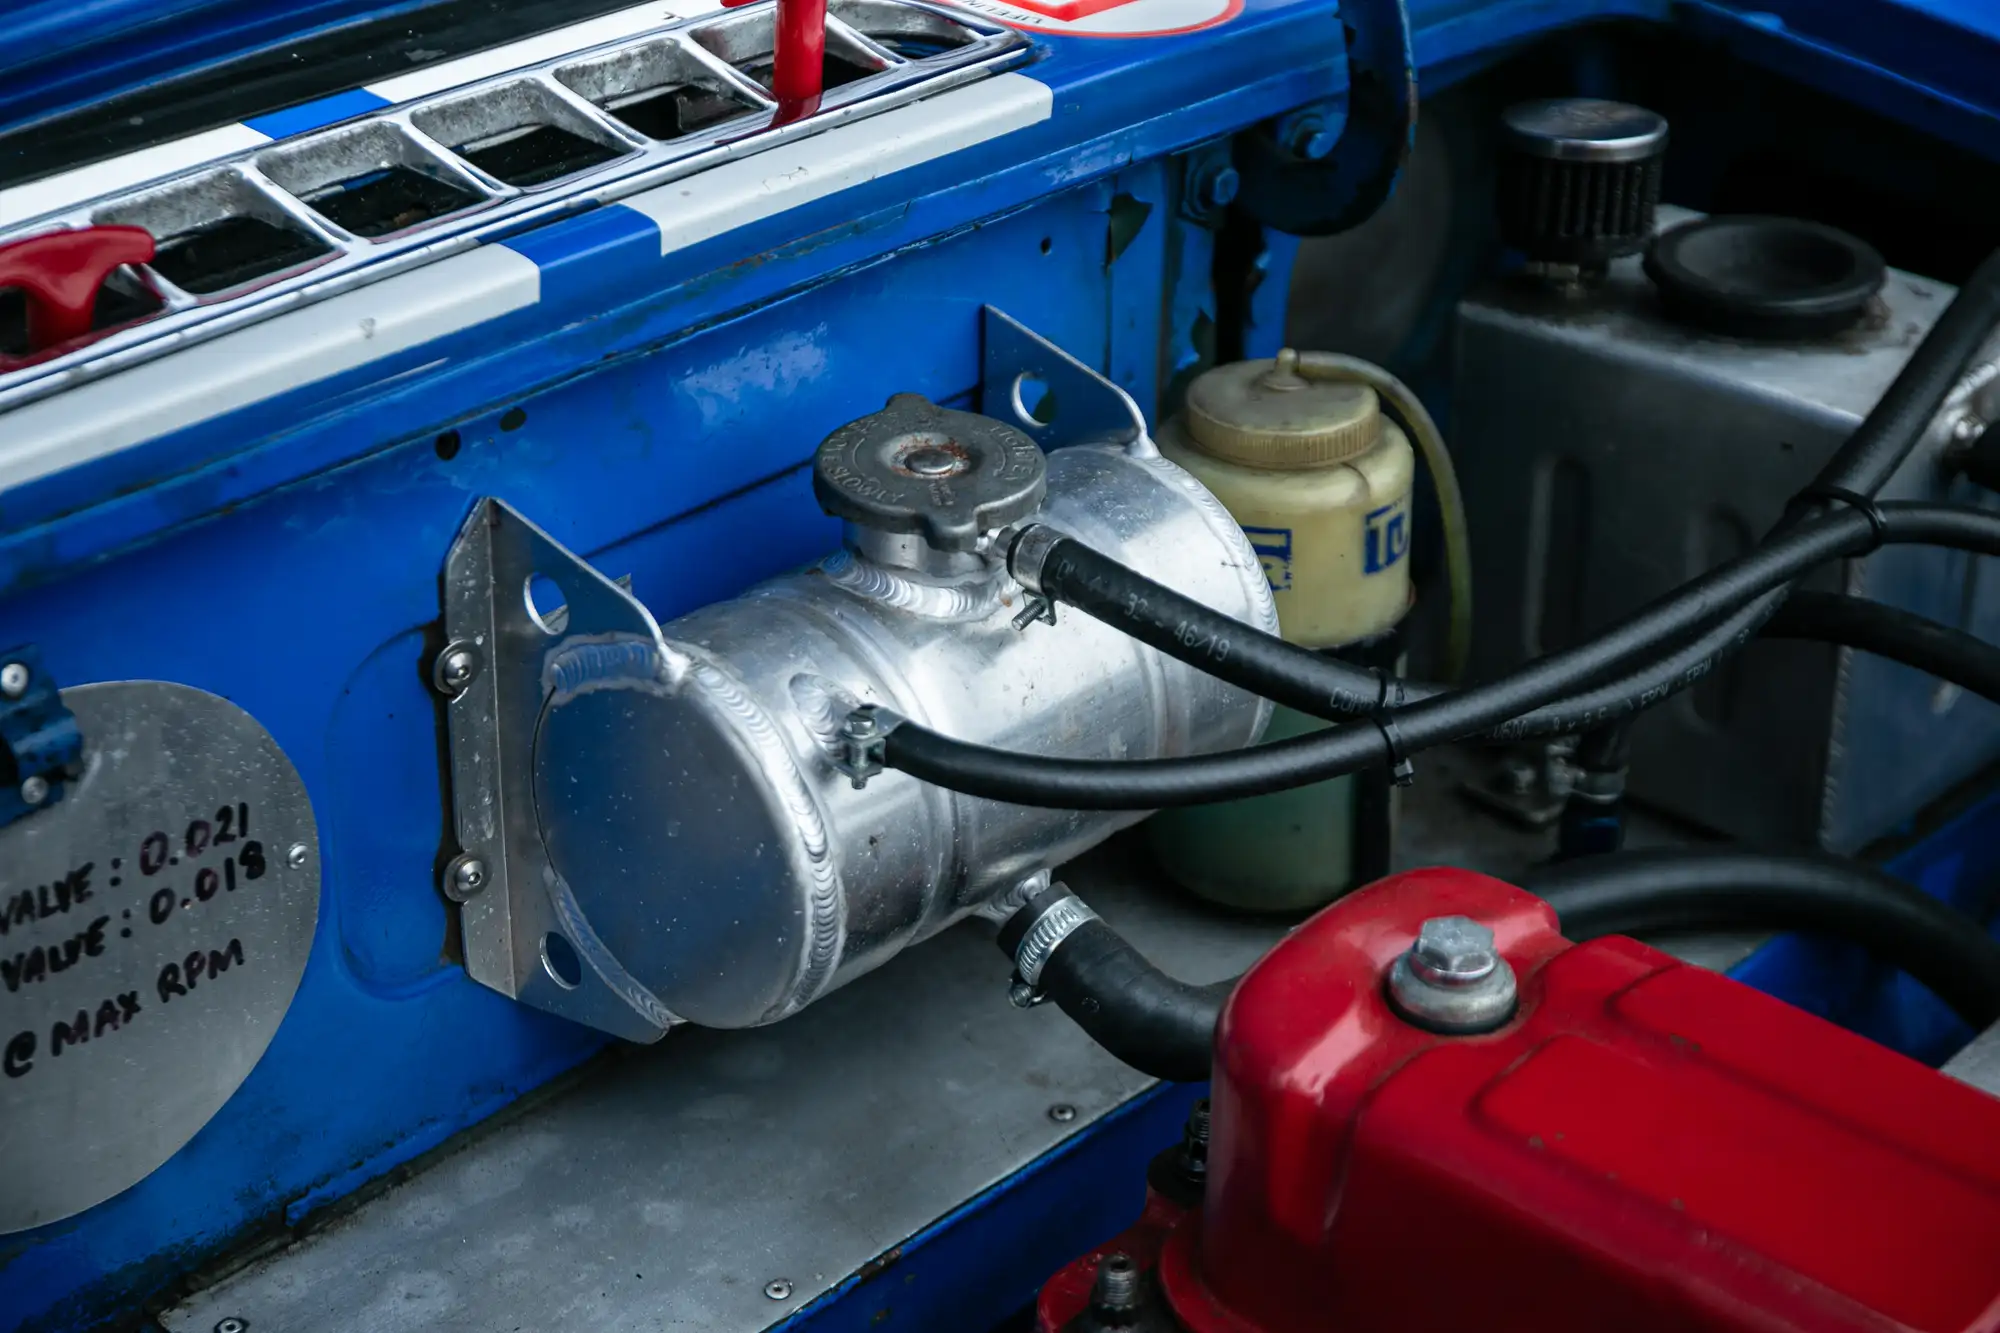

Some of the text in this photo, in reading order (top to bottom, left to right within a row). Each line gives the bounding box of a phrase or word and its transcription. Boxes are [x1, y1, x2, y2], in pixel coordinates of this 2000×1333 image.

[1173, 620, 1231, 662] 46/19
[140, 802, 248, 877] 0.021
[149, 840, 266, 925] 0.018
[52, 990, 141, 1057] MAX
[157, 938, 244, 1003] RPM
